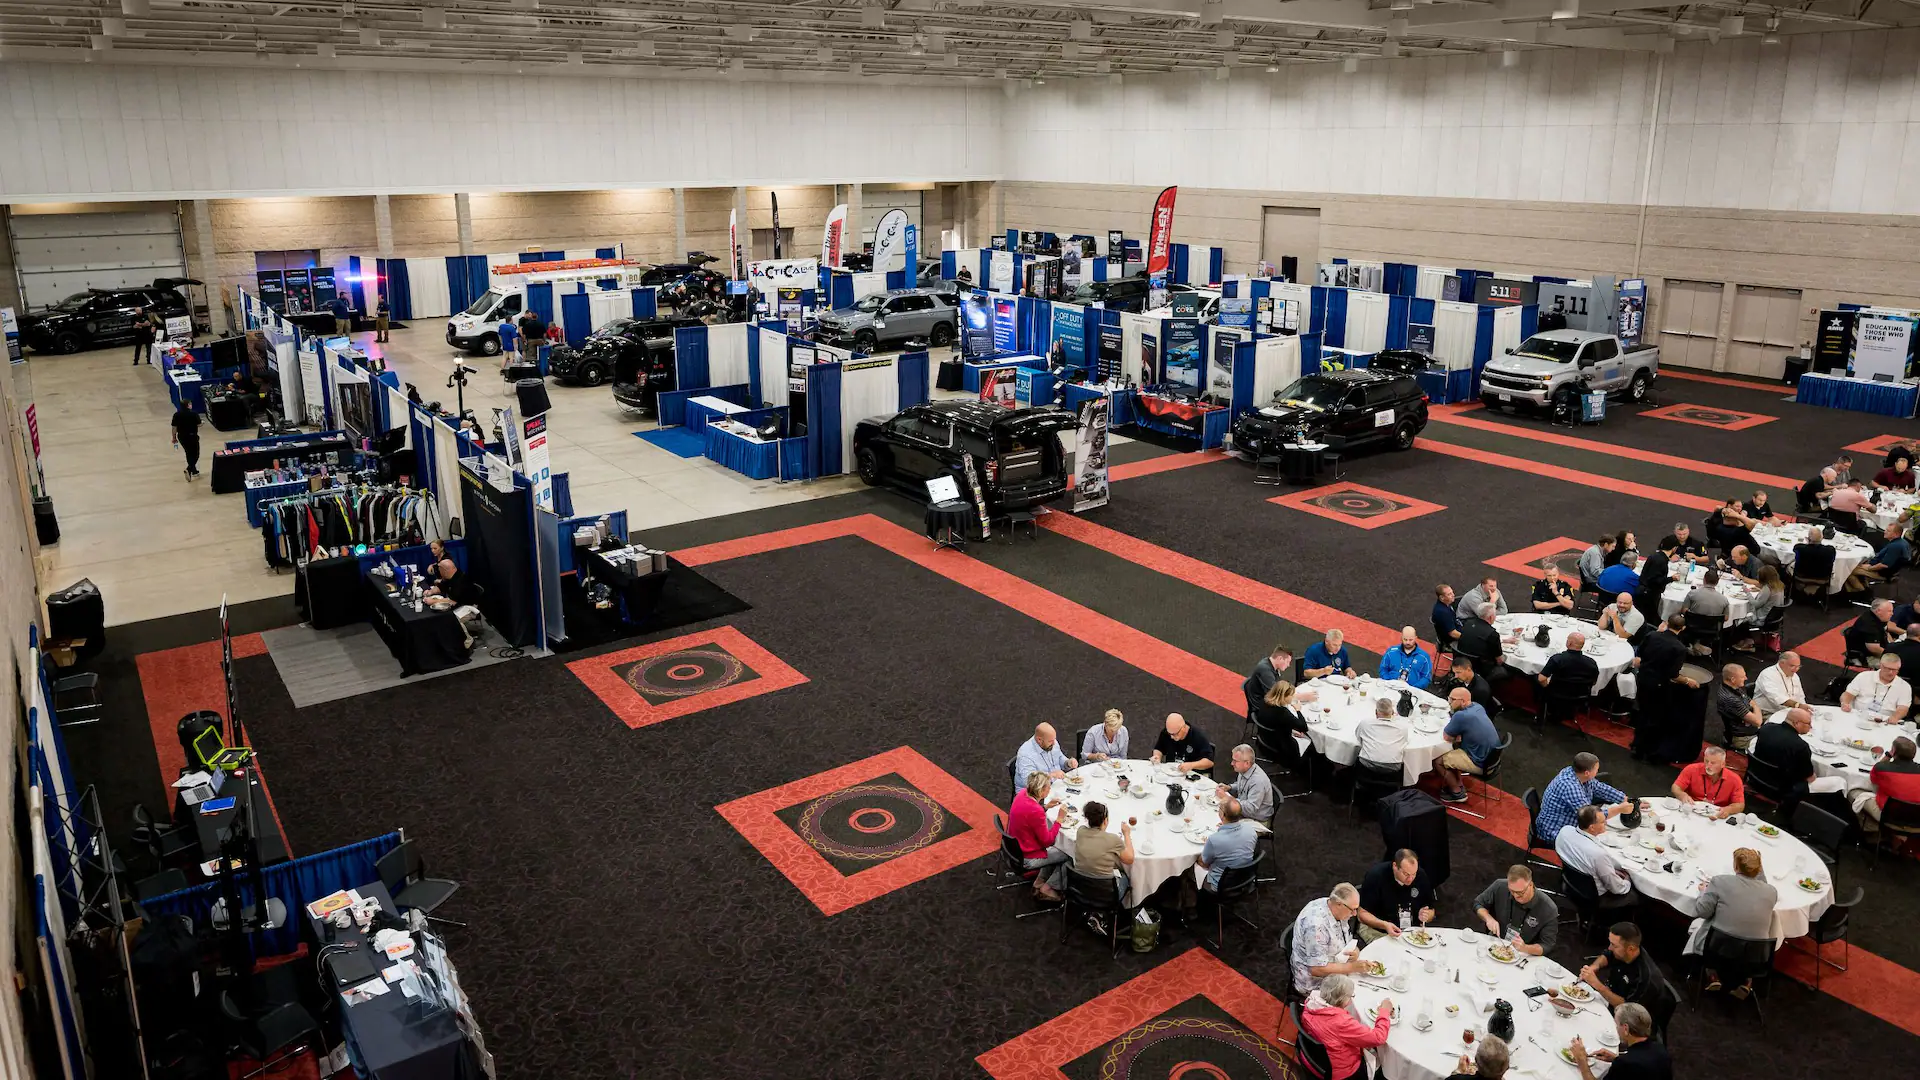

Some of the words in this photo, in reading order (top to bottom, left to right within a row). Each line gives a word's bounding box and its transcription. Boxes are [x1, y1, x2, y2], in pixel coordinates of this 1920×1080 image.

[1153, 207, 1167, 258] WHELEN
[750, 264, 807, 280] TACTICAL
[1490, 285, 1510, 298] 5.11
[1553, 294, 1588, 315] 5.11
[1059, 312, 1069, 321] OFF
[1069, 314, 1083, 323] DUTY
[1865, 323, 1904, 332] EDUCATING
[1888, 330, 1904, 338] WHO
